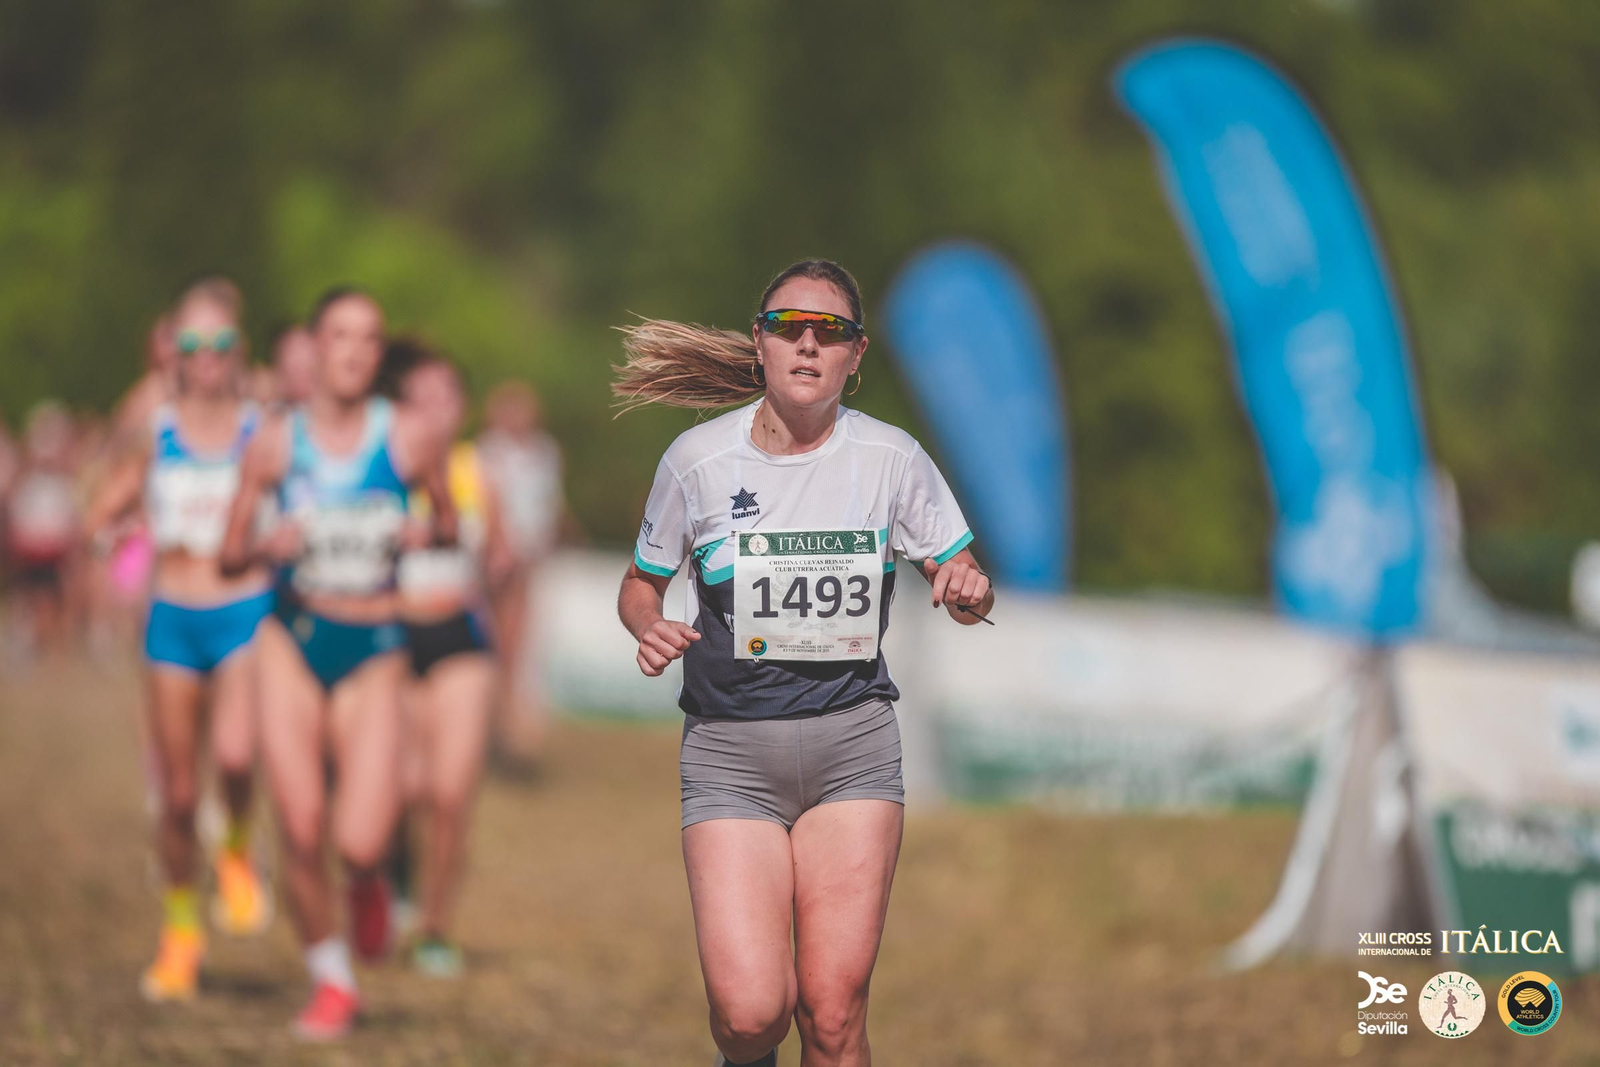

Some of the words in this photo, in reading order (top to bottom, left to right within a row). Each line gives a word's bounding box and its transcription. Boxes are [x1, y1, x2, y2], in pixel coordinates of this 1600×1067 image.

[732, 507, 760, 520] luanvi
[779, 532, 844, 550] ITÁLICA
[752, 575, 871, 618] 1493
